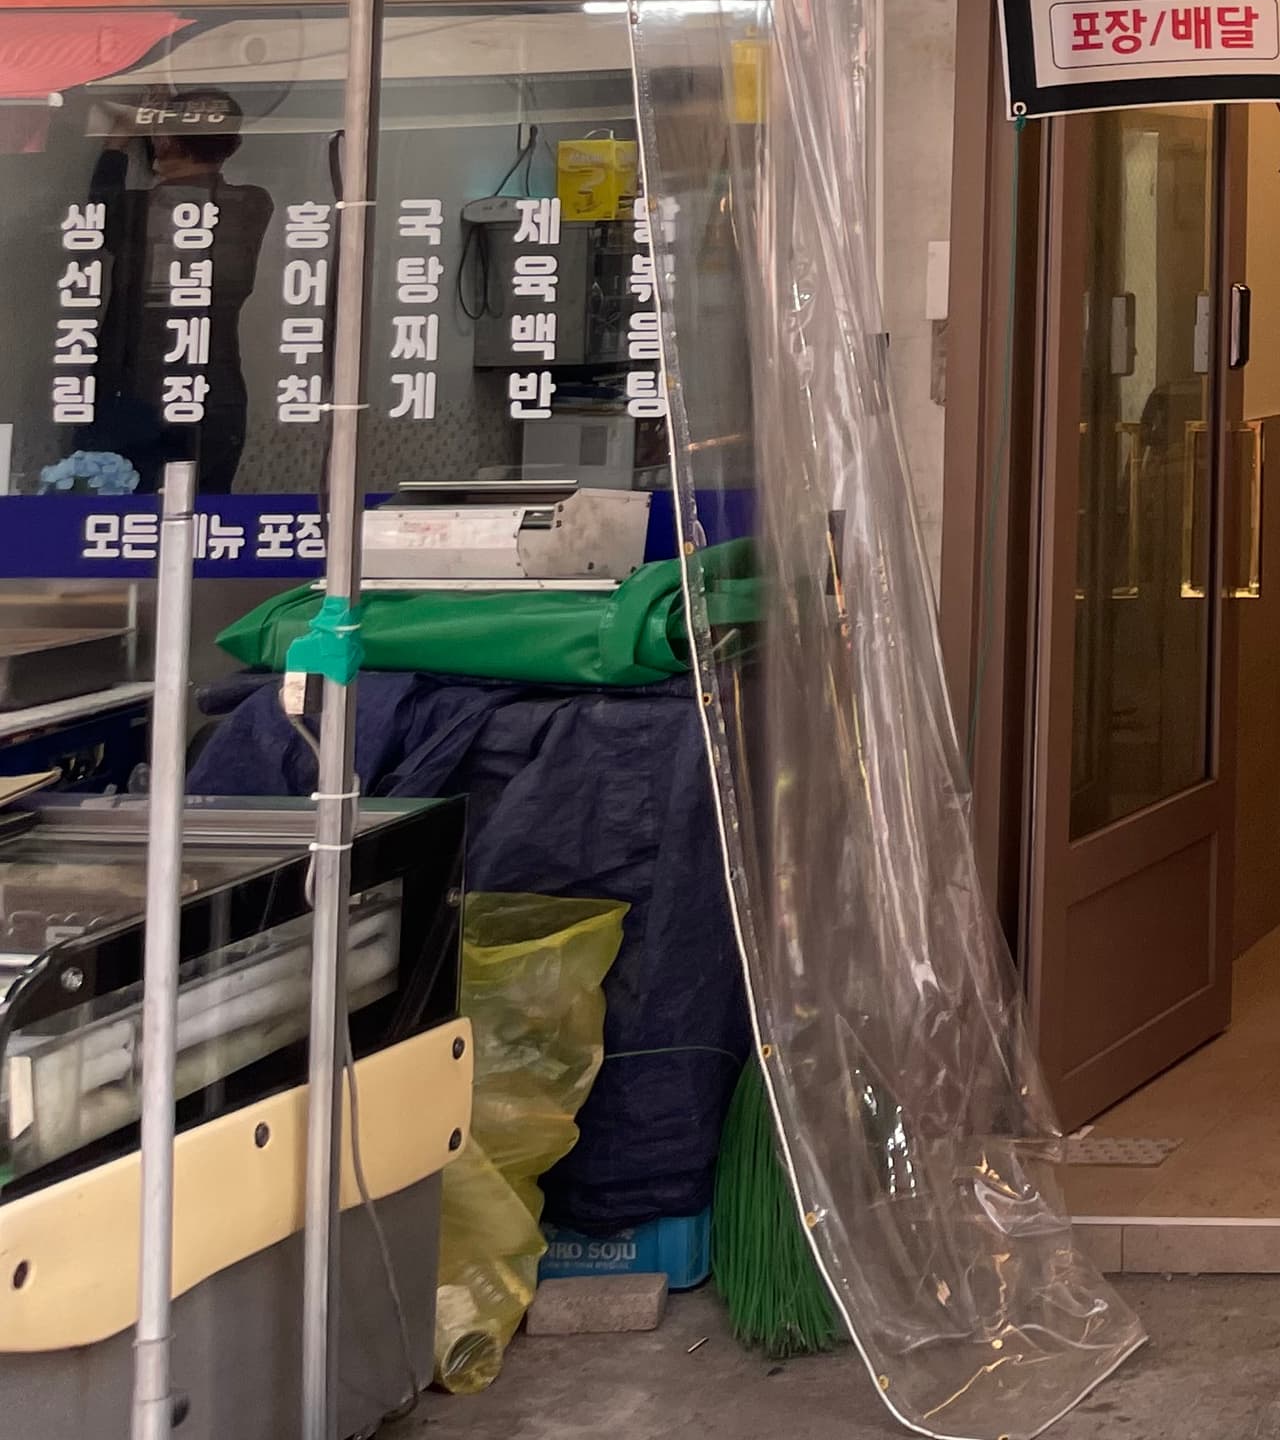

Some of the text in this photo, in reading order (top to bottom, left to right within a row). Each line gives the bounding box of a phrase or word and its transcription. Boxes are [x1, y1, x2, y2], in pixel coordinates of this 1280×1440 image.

[1070, 4, 1260, 56] 포장/배달
[51, 201, 108, 426] 생선조림
[161, 201, 221, 426] 양념게장
[276, 199, 332, 426] 홍어무침
[388, 197, 445, 421] 국탕찌게
[507, 196, 562, 421] 제육백반
[81, 513, 160, 560] 모든
[588, 1242, 637, 1262] SOJU
